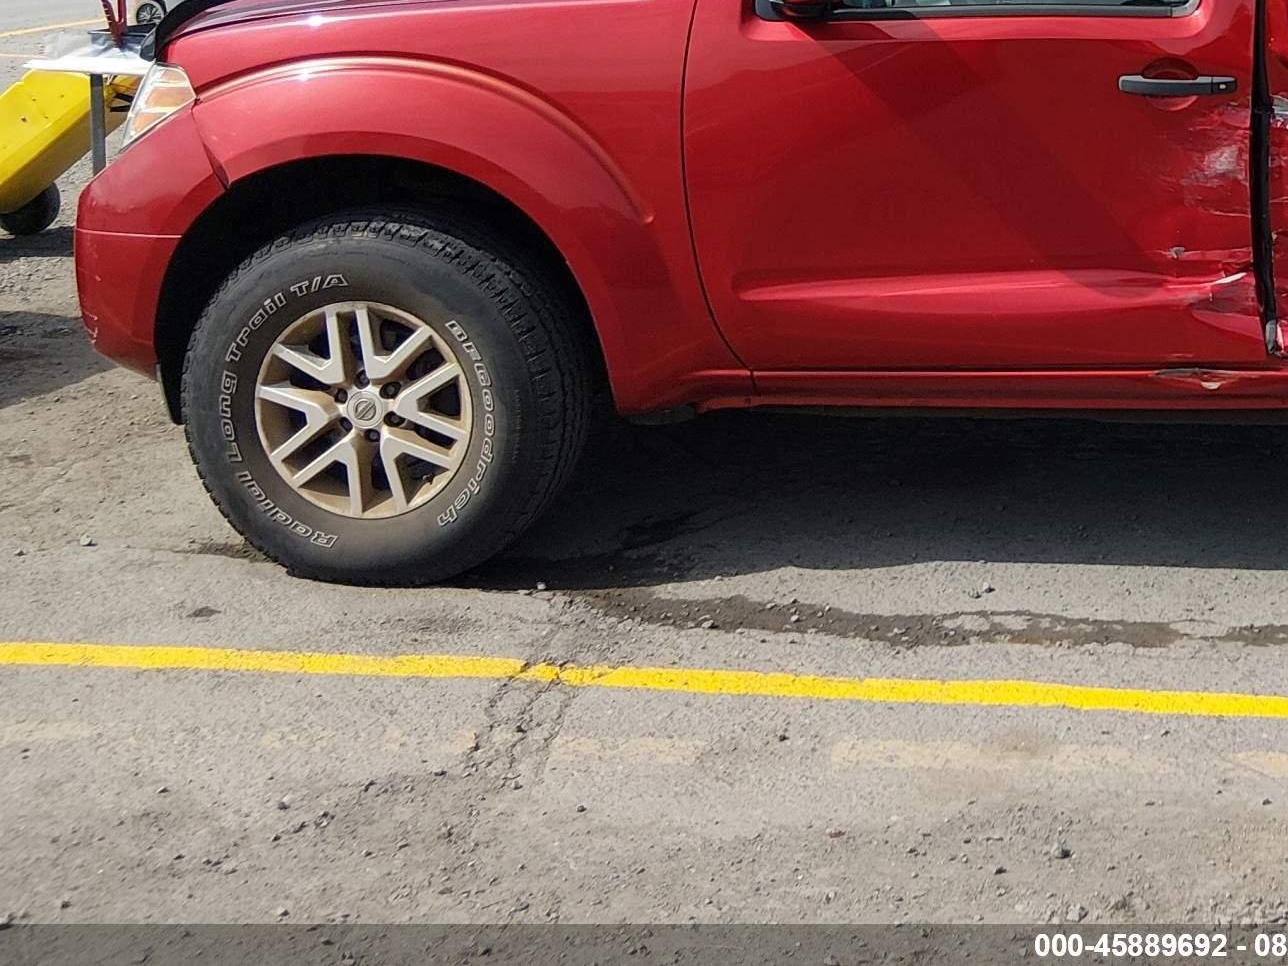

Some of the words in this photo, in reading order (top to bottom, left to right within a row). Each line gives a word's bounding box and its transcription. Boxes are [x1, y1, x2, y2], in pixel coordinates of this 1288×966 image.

[291, 274, 349, 296] T/A
[225, 292, 287, 362] Trail
[219, 371, 242, 464] Long
[438, 320, 496, 527] BFGoodrich
[236, 471, 339, 548] Radial
